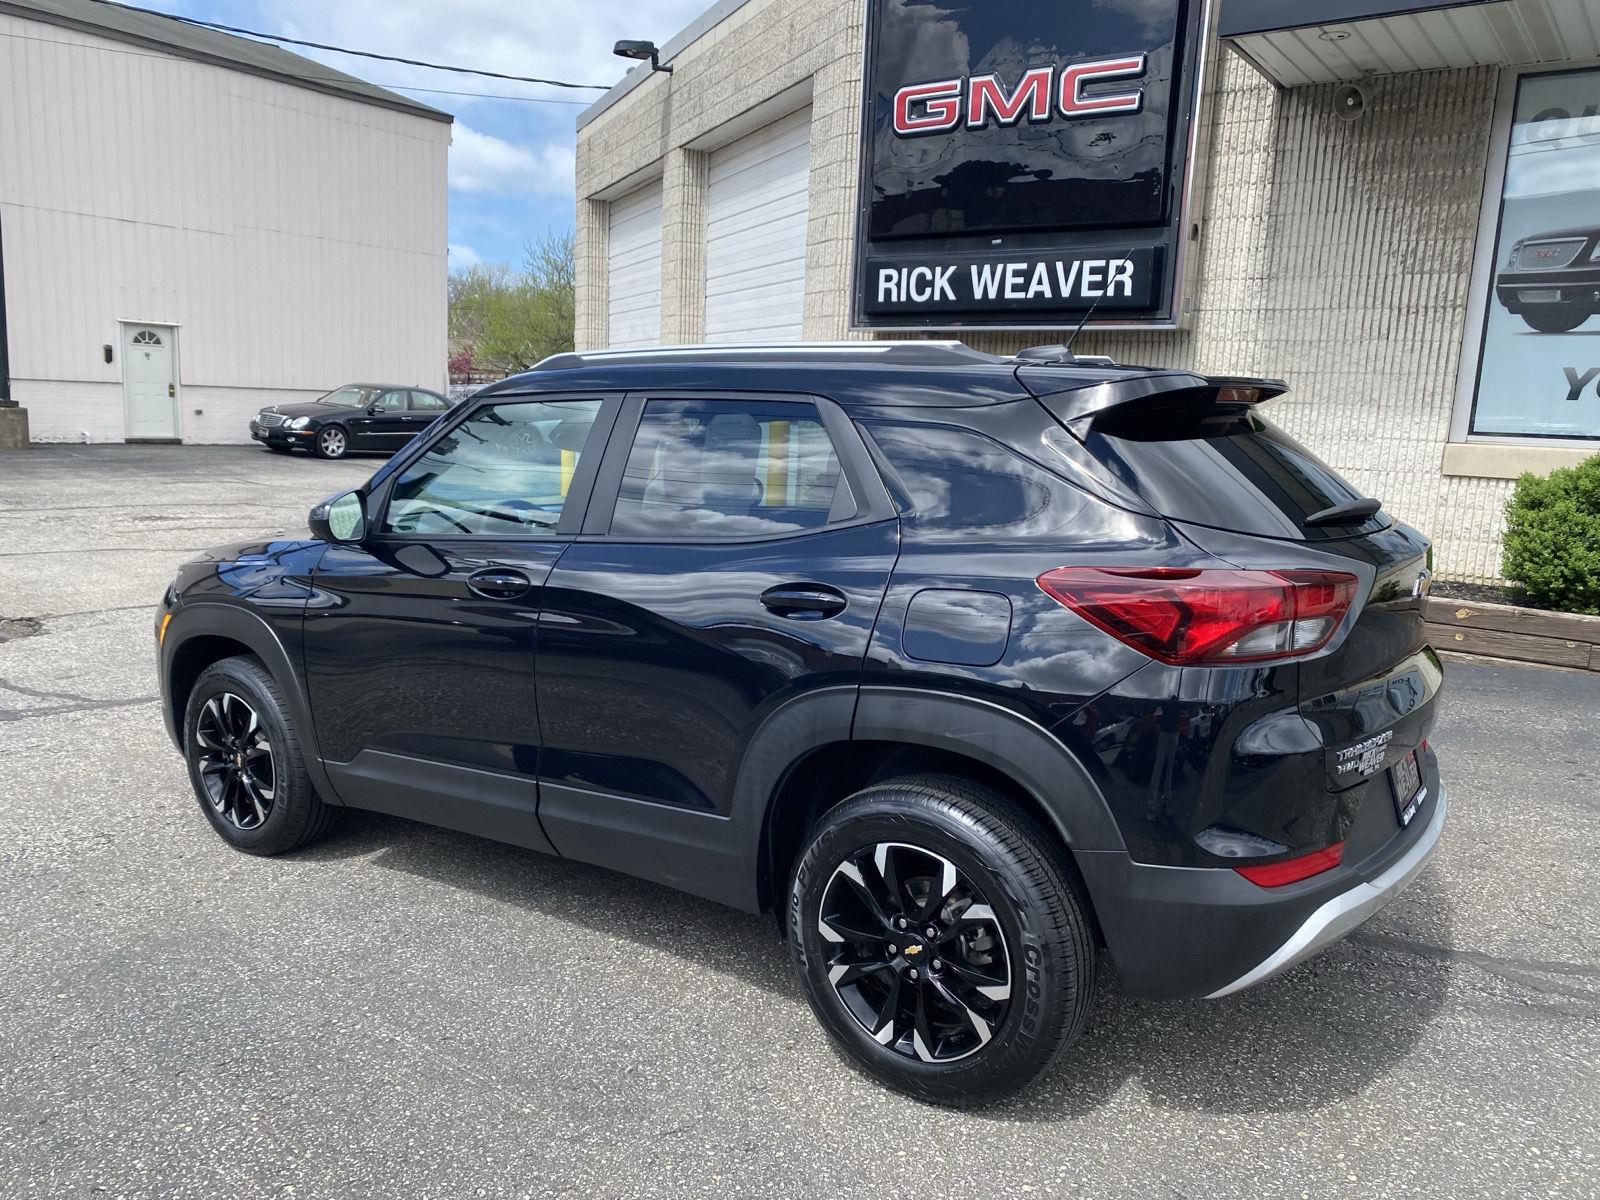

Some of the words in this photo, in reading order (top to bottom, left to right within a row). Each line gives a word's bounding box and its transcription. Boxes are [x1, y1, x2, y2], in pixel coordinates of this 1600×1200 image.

[893, 54, 1146, 136] GMC
[877, 266, 957, 303] RICK
[970, 258, 1135, 300] WEAVER
[1563, 367, 1600, 401] Y
